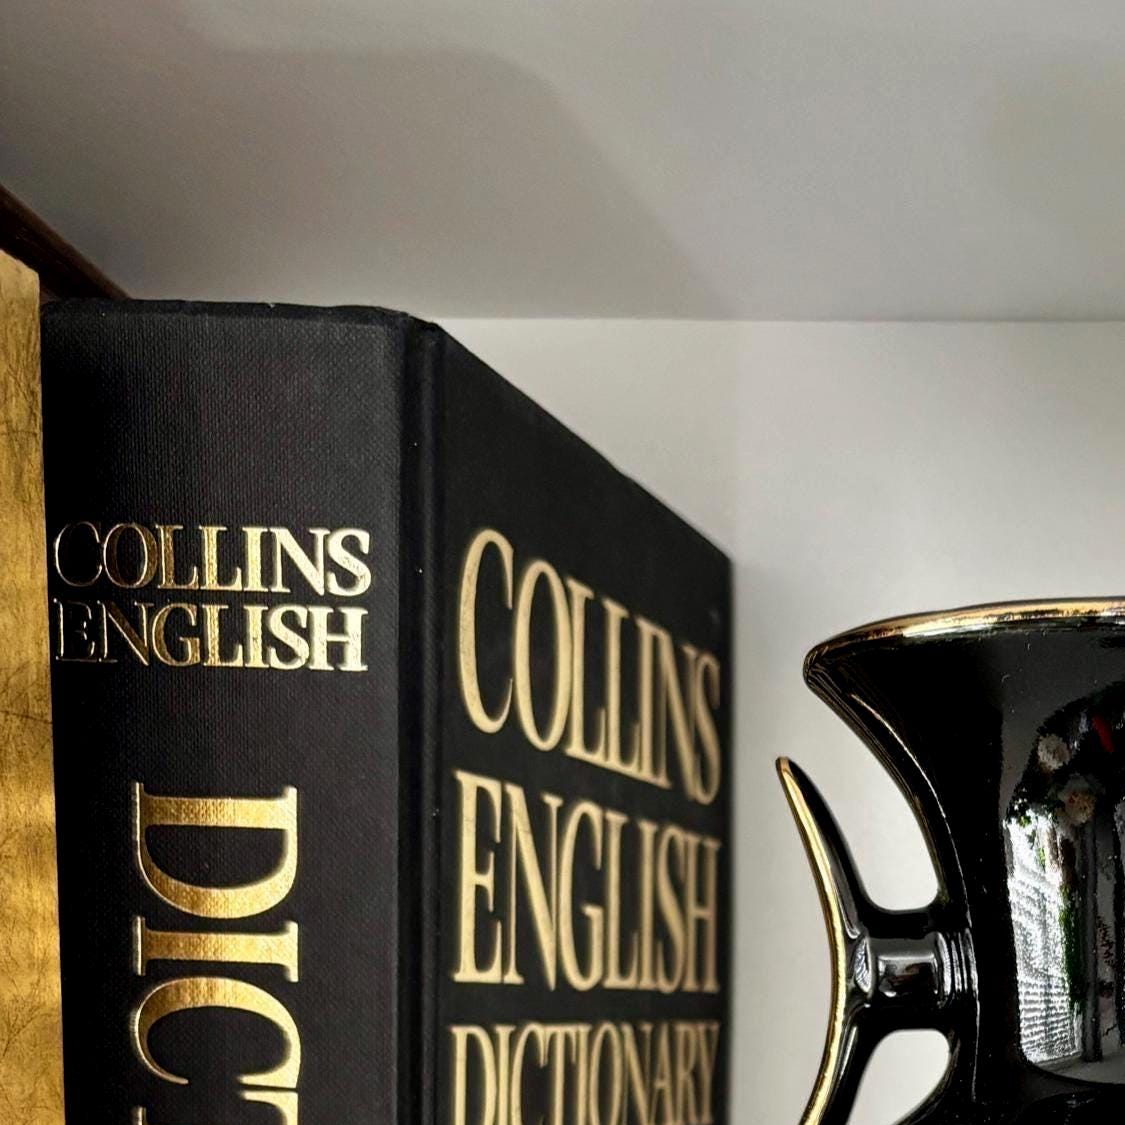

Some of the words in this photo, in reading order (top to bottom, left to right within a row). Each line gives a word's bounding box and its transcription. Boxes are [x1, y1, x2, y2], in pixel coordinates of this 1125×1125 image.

[53, 521, 372, 597] COLLINS
[53, 598, 369, 672] ENGLISH
[458, 529, 721, 805] COLLINS
[452, 769, 722, 994] ENGLISH
